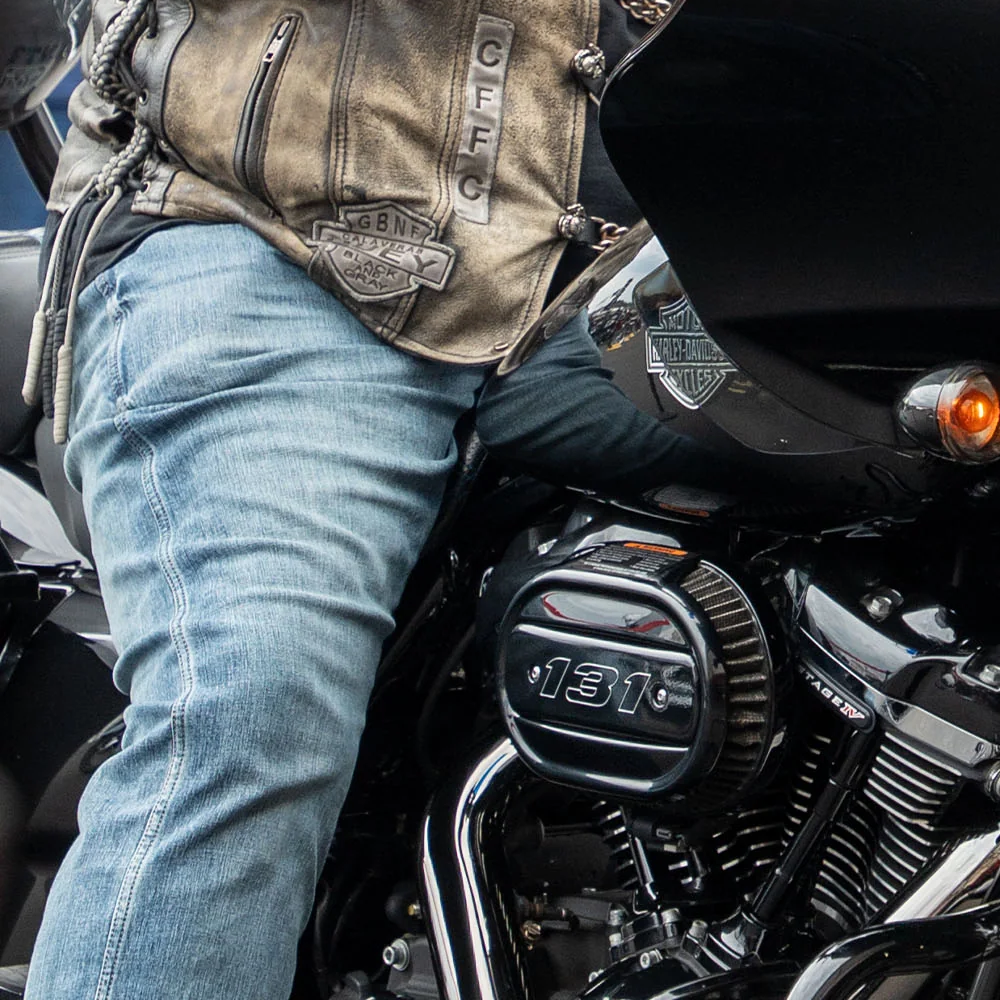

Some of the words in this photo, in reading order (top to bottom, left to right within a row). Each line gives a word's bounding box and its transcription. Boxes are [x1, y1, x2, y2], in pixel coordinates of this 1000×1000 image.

[358, 212, 421, 239] GBNF
[343, 250, 399, 280] BLACK
[354, 263, 382, 280] AND
[343, 268, 389, 291] GRAY
[668, 306, 703, 330] MOTO
[652, 338, 729, 361] HARLEY-DAVIDS
[539, 656, 651, 715] 131
